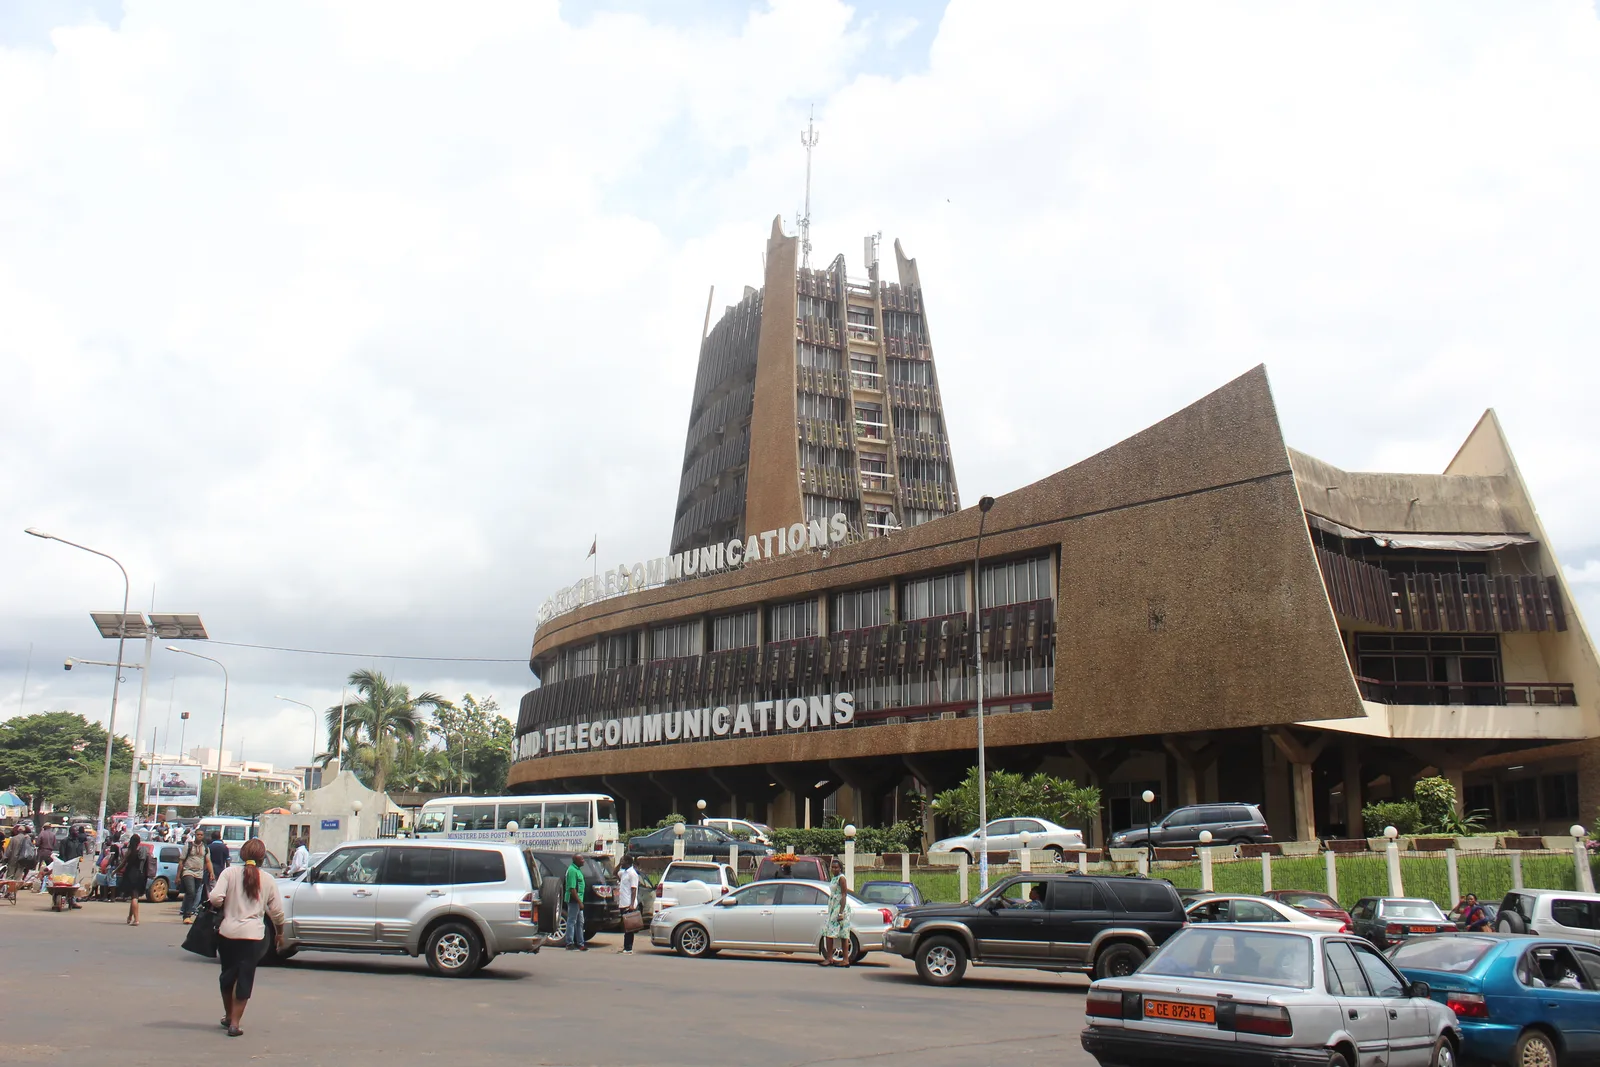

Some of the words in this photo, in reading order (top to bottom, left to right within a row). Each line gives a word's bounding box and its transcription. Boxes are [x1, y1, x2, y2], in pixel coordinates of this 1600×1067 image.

[573, 512, 848, 606] TELECOMMUNICATIONS
[519, 731, 541, 758] AND
[545, 692, 855, 753] TELECOMMUNICATIONS
[522, 829, 587, 839] TELECOMMUNICATIONS
[1157, 1003, 1169, 1016] CE
[1172, 1005, 1196, 1018] 8754
[1200, 1008, 1206, 1020] G
